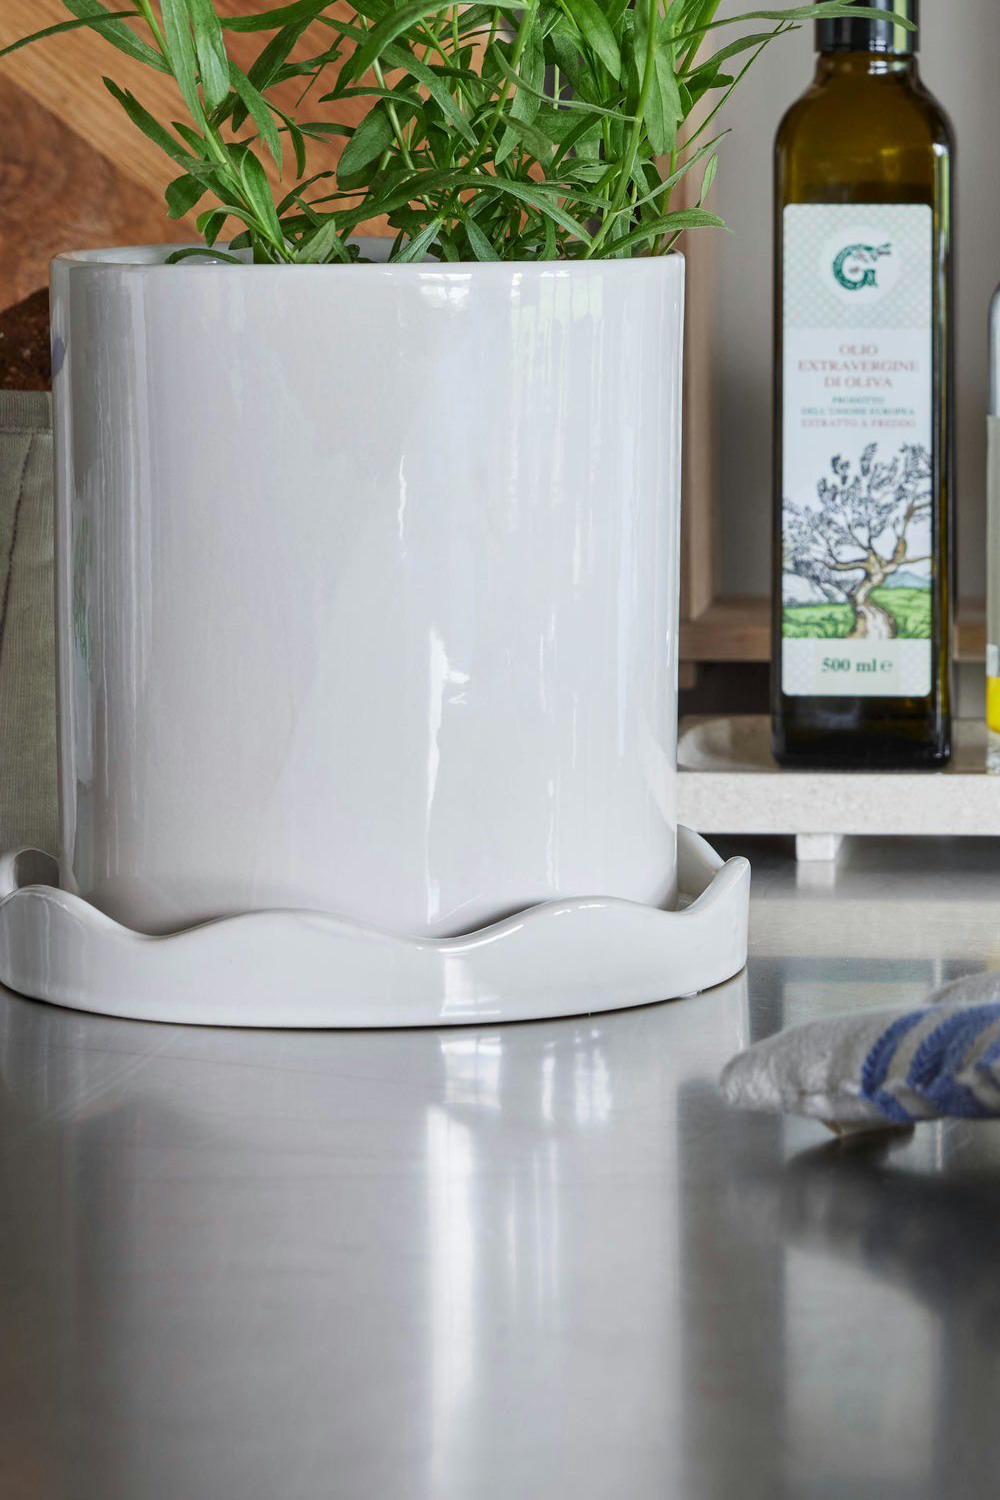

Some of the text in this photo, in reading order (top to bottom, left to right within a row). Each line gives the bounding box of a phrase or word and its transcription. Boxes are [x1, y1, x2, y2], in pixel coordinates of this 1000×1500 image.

[839, 343, 878, 355] OLIO
[797, 360, 918, 372] EXTRAVERGINE
[824, 376, 893, 388] DI OLIVA
[821, 657, 851, 673] 500
[855, 657, 877, 673] ml
